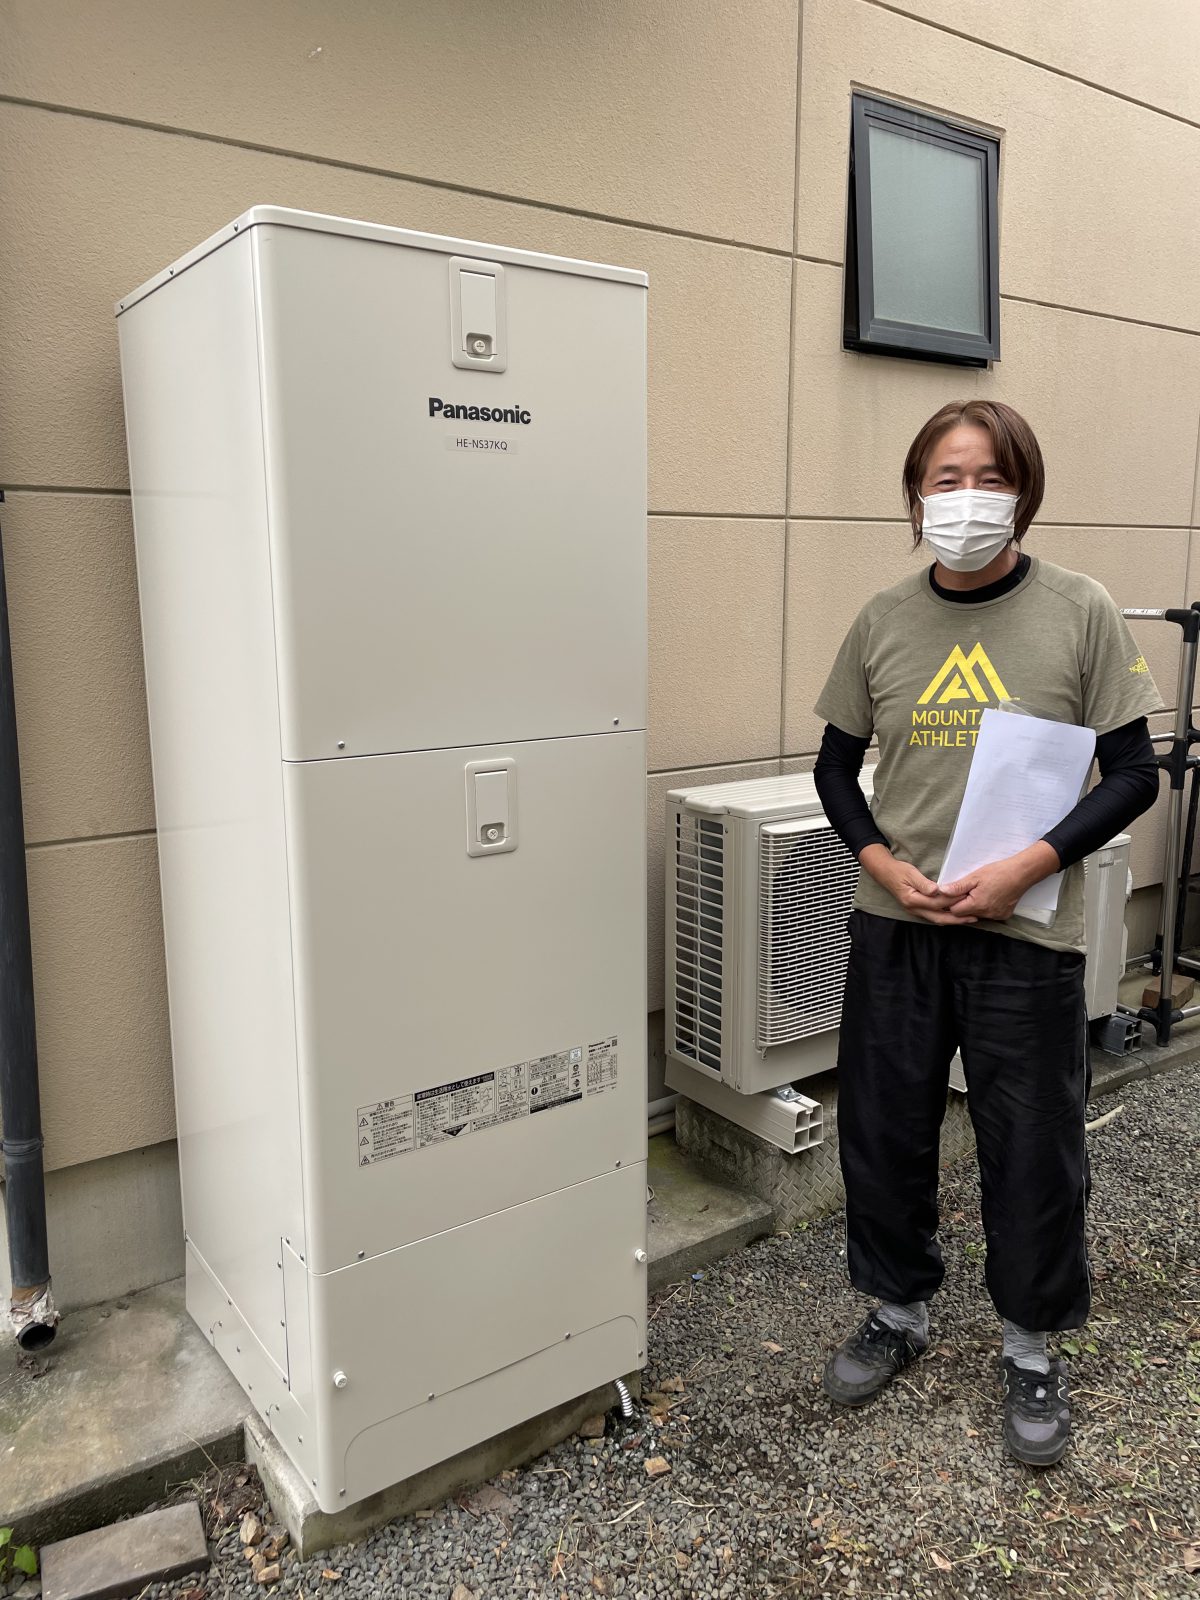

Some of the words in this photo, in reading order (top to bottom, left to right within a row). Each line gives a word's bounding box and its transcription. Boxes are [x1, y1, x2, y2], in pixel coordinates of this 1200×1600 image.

[429, 397, 531, 424] Panasonic
[456, 438, 508, 451] HE-NS37KQ
[912, 709, 982, 726] MOUNT
